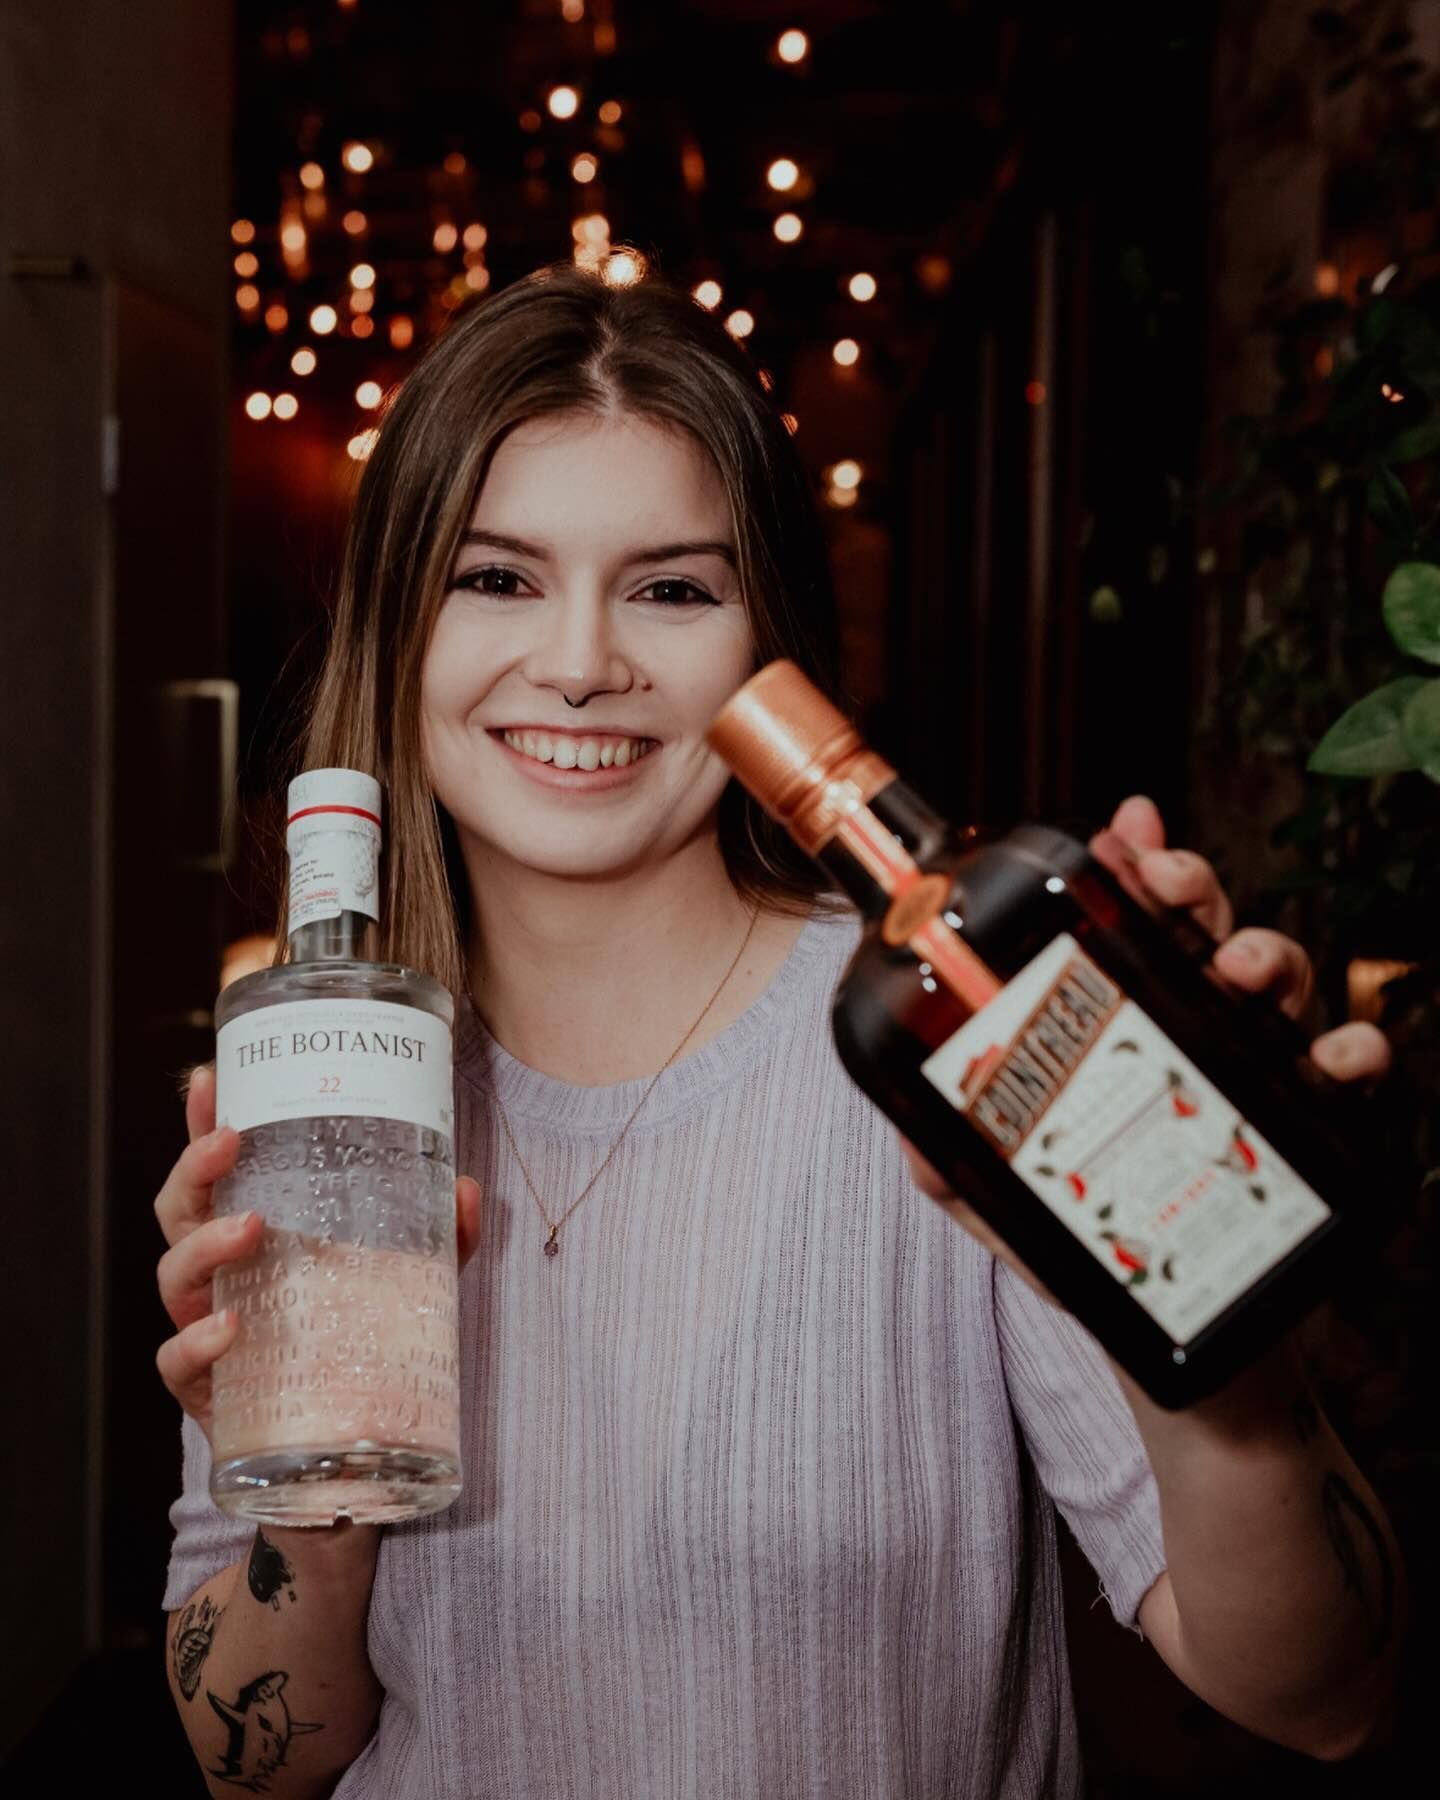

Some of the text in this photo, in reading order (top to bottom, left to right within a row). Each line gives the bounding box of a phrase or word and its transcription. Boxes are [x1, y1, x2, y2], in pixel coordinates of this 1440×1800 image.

[236, 1030, 426, 1069] THE BOTANIST
[974, 960, 1120, 1147] COINTREAU
[319, 1076, 341, 1094] 22
